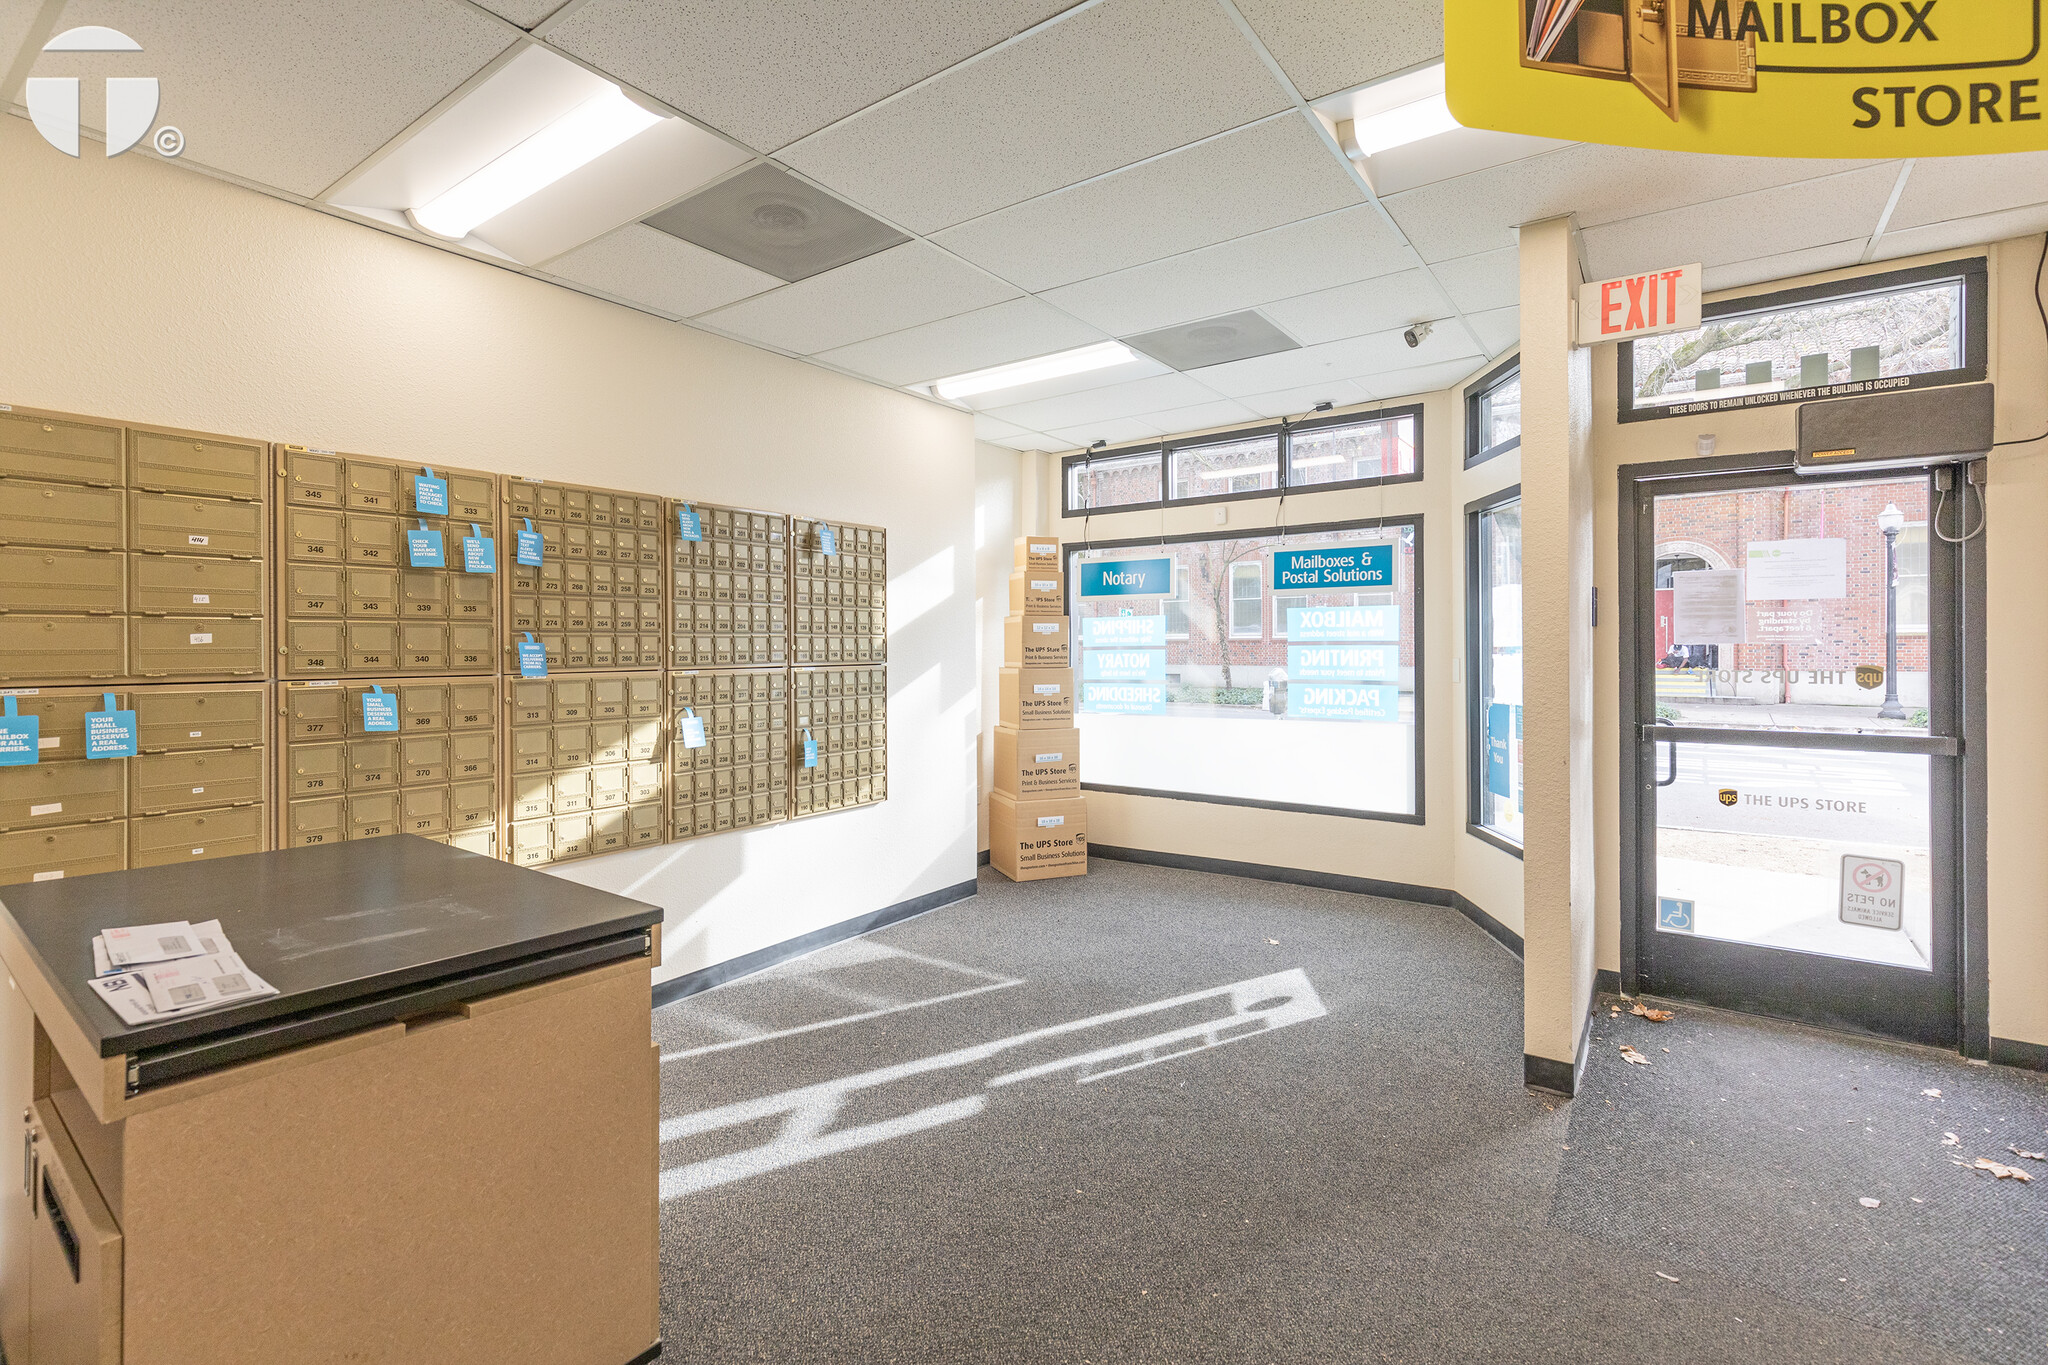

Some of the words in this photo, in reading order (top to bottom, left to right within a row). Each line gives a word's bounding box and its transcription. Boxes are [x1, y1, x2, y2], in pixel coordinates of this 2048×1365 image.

[1687, 0, 1939, 44] MAILBOX
[1851, 78, 2042, 129] STORE
[1601, 269, 1683, 335] EXIT
[1669, 406, 1687, 414] THESE
[1688, 403, 1708, 413] DOORS
[1719, 398, 1744, 409] REMAIN
[1744, 394, 1778, 406] UNLOCKED
[1779, 388, 1816, 401] WHENEVER
[1817, 386, 1830, 396] THE
[1832, 382, 1863, 395] BUILDING
[1865, 381, 1872, 390] IS
[1874, 377, 1910, 390] OCCUPIED
[305, 490, 322, 498] 345
[364, 496, 378, 504] 341
[307, 545, 324, 554] 346
[363, 549, 378, 557] 342
[1291, 552, 1354, 570] Mailboxes
[1362, 552, 1372, 566] &
[1102, 571, 1146, 588] Notary
[1282, 571, 1318, 585] Postal
[1323, 568, 1383, 583] Solutions
[308, 658, 324, 666] 348
[1491, 736, 1507, 750] Thank
[1493, 752, 1503, 764] You
[307, 780, 324, 788] 378
[1720, 793, 1737, 803] ups
[1744, 794, 1772, 806] THE
[1778, 796, 1809, 809] UPS
[1816, 799, 1867, 813] STORE
[465, 812, 479, 821] 367
[416, 820, 430, 828] 371
[364, 826, 380, 836] 375
[306, 834, 323, 844] 379
[1036, 840, 1051, 848] UPS
